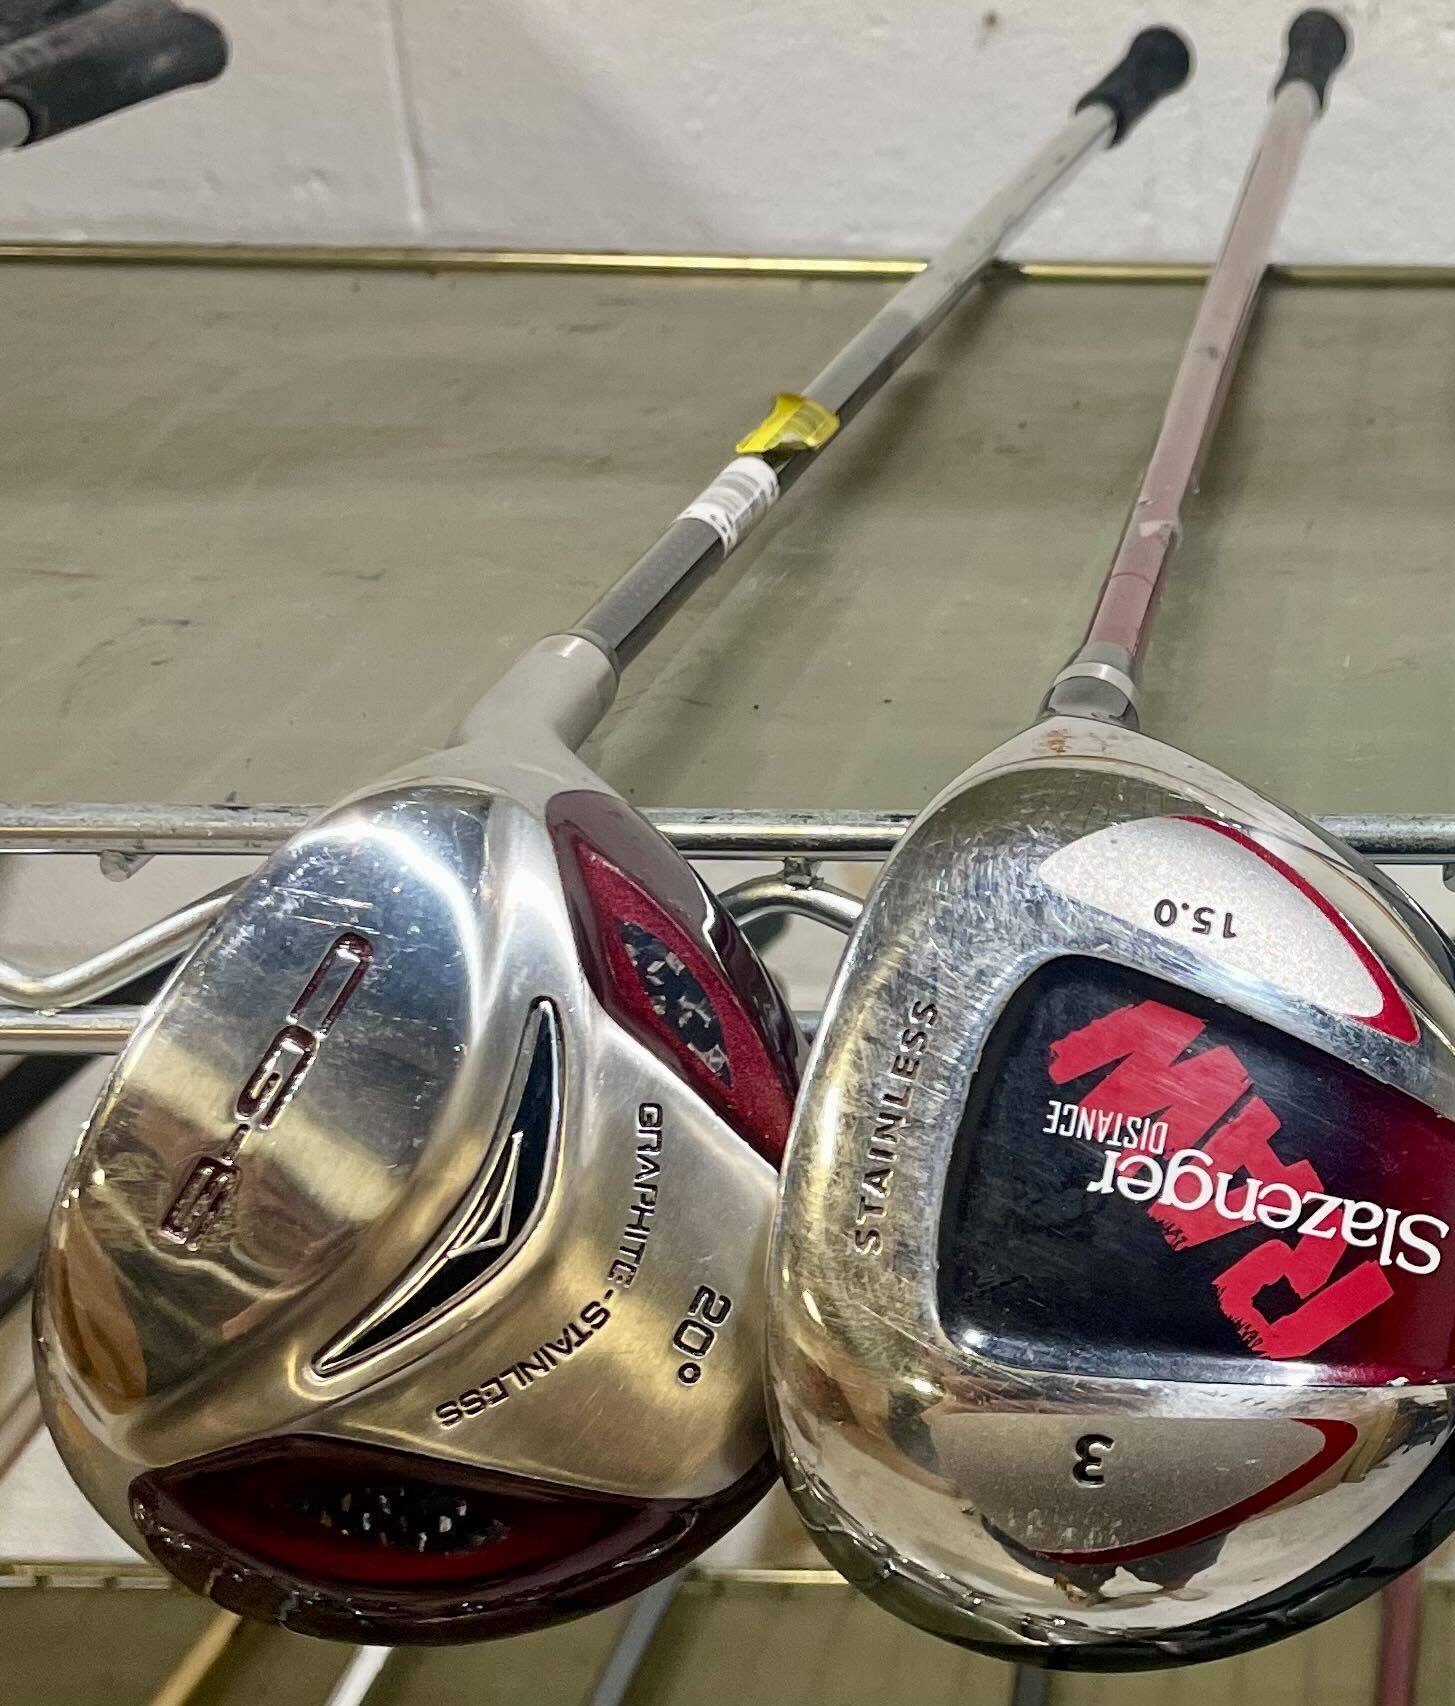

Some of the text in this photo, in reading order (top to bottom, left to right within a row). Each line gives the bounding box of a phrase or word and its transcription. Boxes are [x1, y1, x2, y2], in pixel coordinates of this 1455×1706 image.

[1152, 895, 1239, 942] 15.0
[853, 998, 942, 1256] STAINLESS
[1042, 1099, 1171, 1156] DISTANCE
[1046, 999, 1396, 1359] RAM
[1085, 1147, 1452, 1277] Slazenger
[1073, 1431, 1116, 1489] 3
